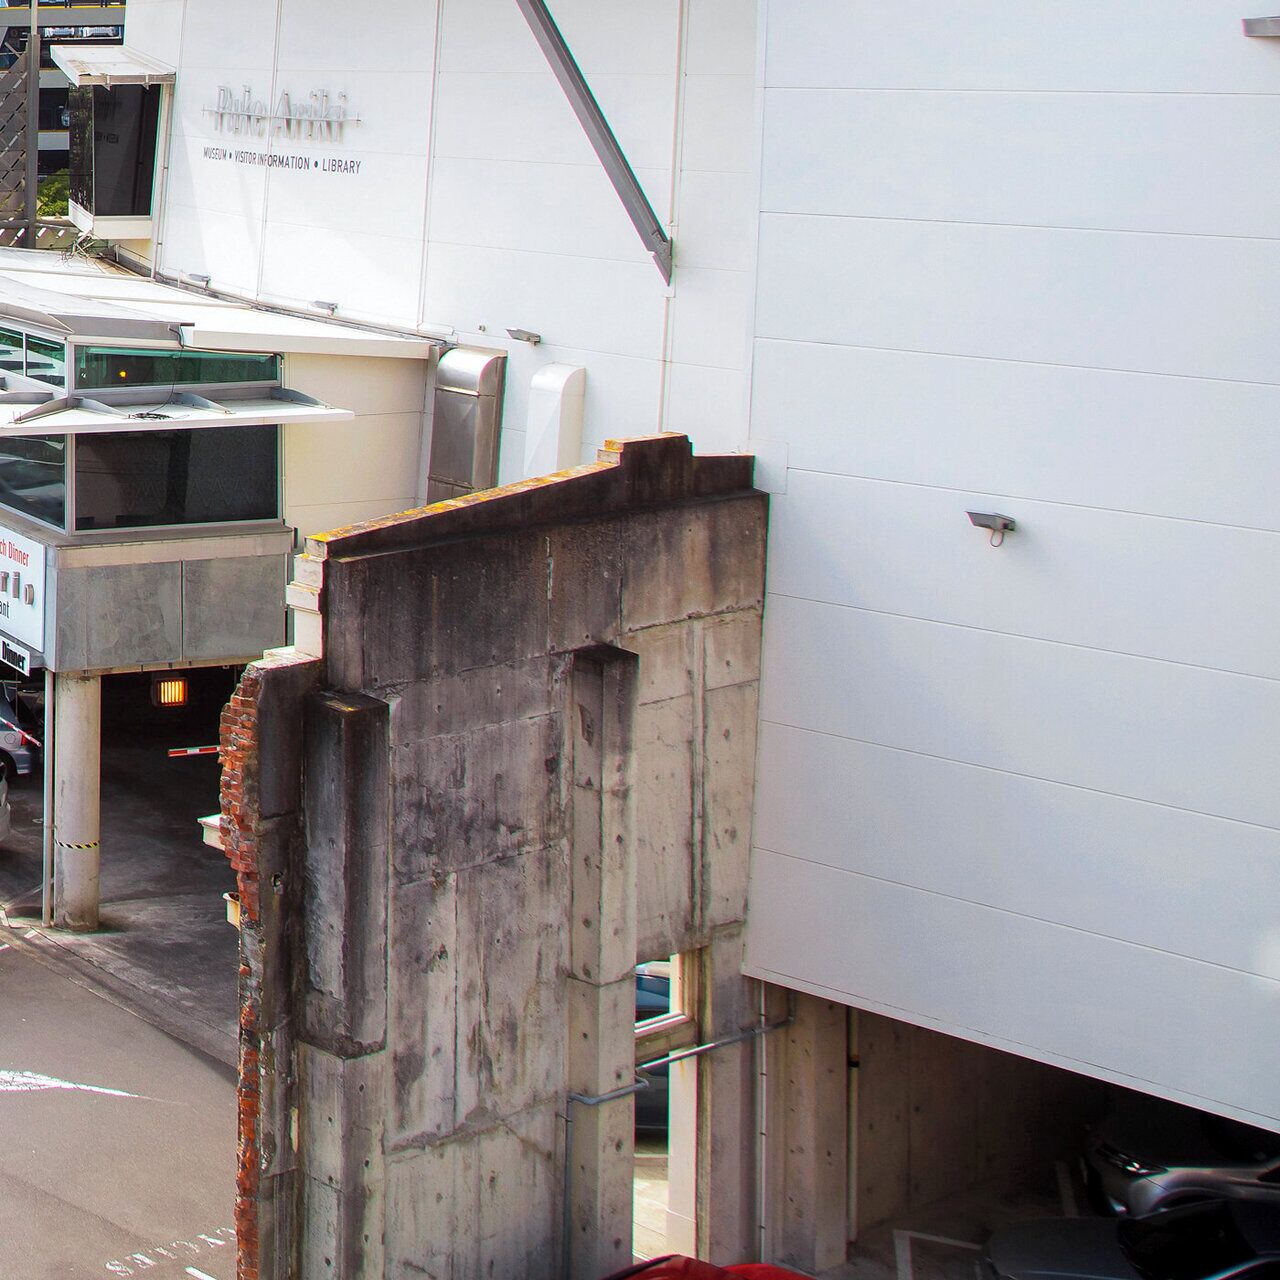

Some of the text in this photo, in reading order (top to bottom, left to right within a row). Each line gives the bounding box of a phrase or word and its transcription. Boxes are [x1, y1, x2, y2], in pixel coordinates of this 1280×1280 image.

[203, 147, 361, 174] MUSEUM VISITOR INFORMATION LIBRARY
[8, 541, 30, 567] Dinner
[2, 640, 27, 670] Dinner
